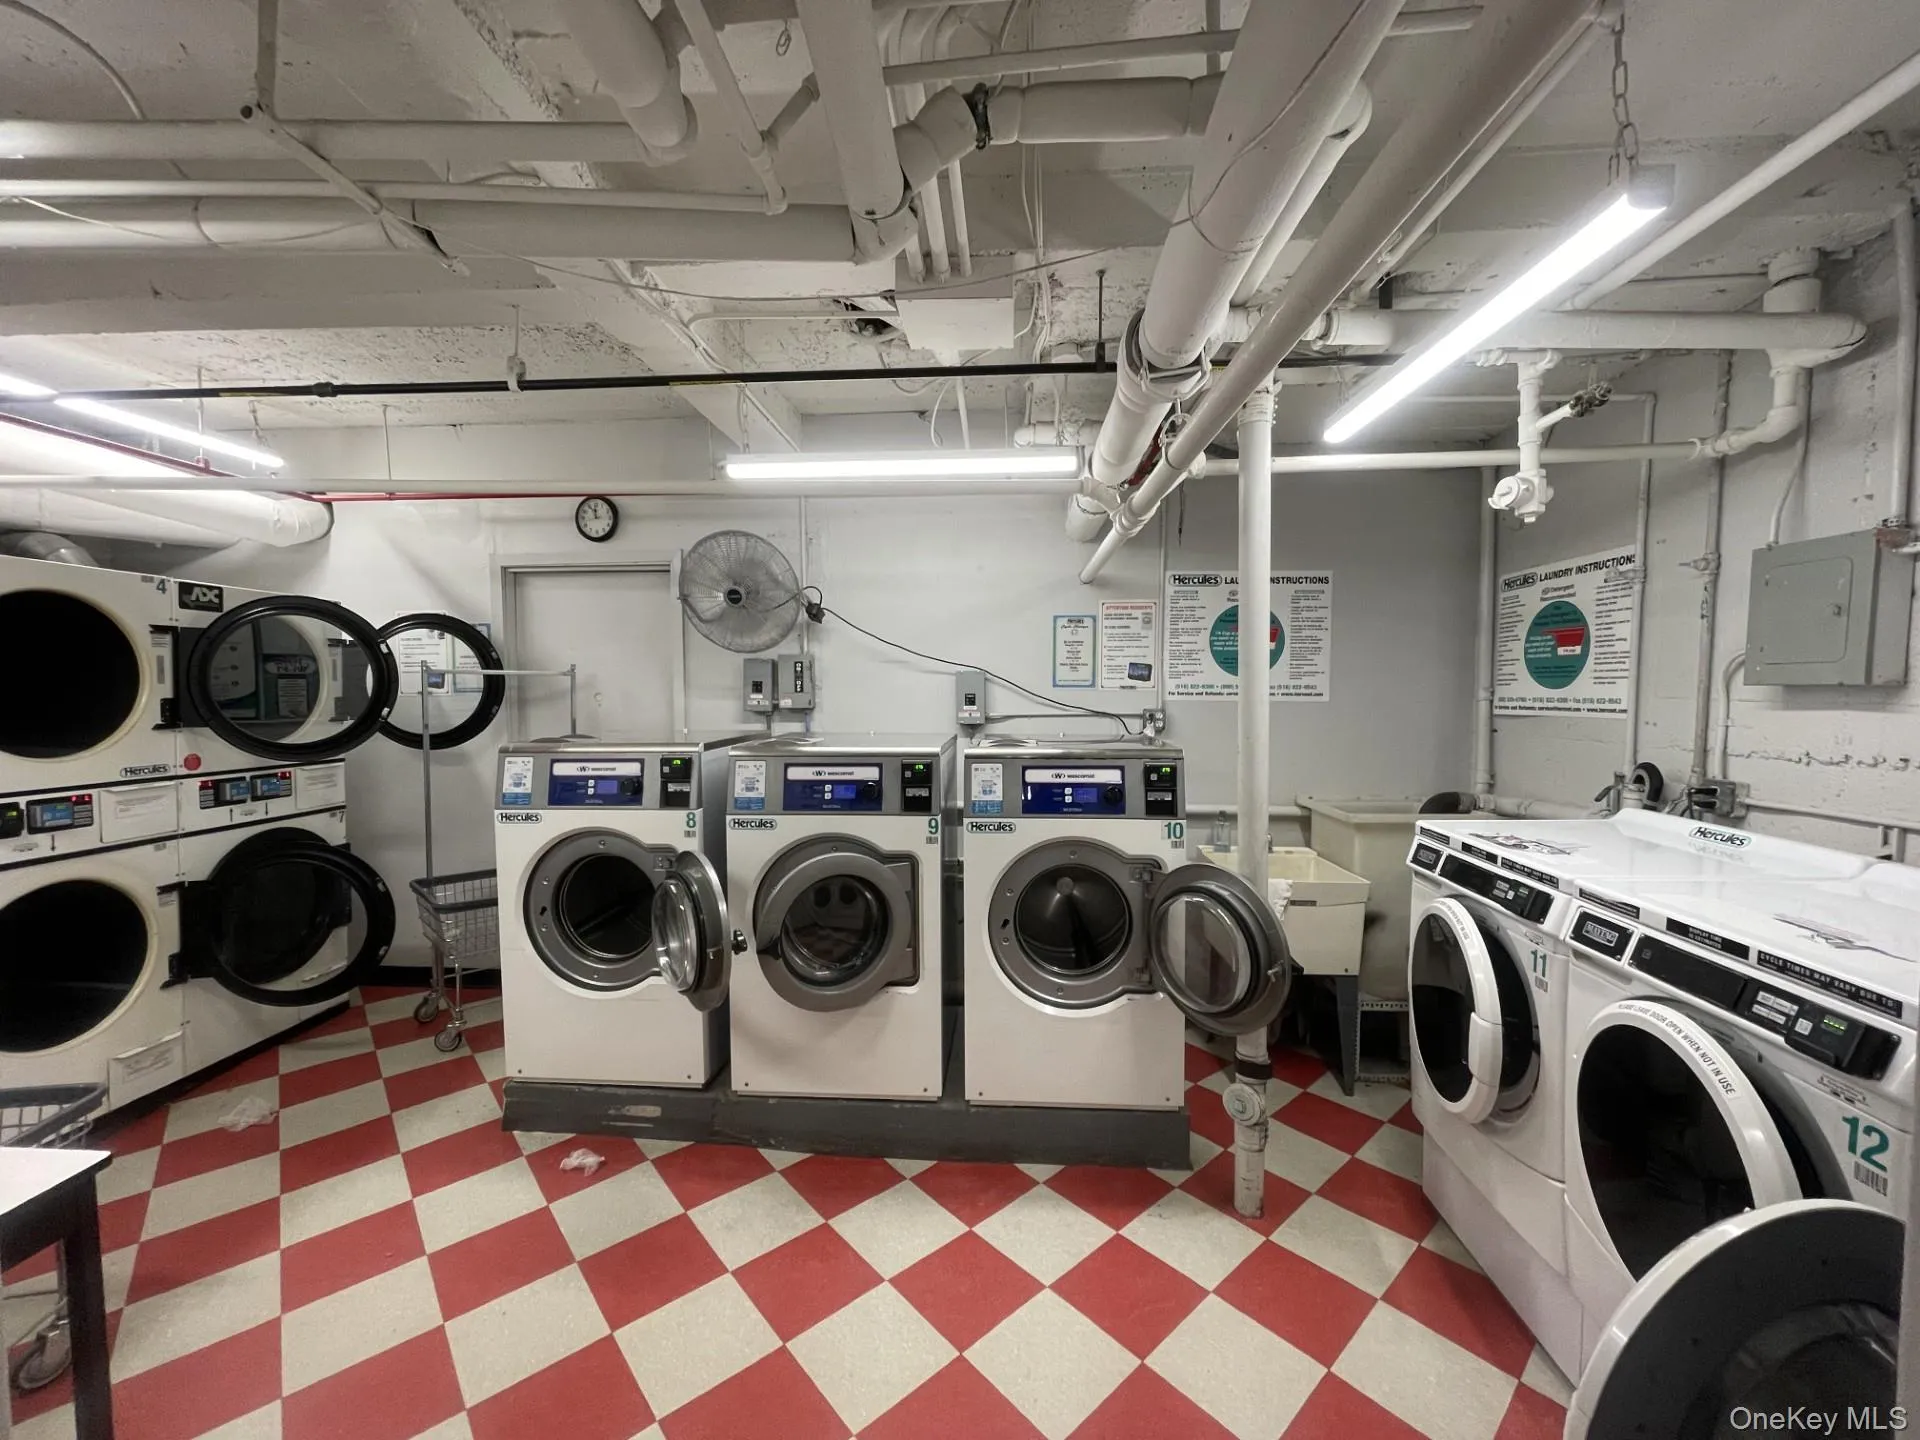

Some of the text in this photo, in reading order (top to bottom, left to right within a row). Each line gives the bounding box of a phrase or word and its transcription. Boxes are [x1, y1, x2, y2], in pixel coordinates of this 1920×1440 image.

[156, 578, 167, 594] 4
[1173, 574, 1219, 585] Hercules
[1270, 576, 1330, 584] NSTRUCTIONS
[1503, 574, 1536, 588] Hercules
[1539, 568, 1574, 582] LAUNDRY
[124, 765, 168, 776] Hercules
[500, 812, 696, 828] Hercules 8
[733, 817, 939, 835] Hercules 9
[970, 822, 1184, 840] Hercules 10
[1694, 826, 1746, 846] Hercules
[1530, 950, 1547, 978] 11
[1760, 952, 1783, 966] CYCLE
[1786, 962, 1810, 976] TIMES
[1814, 971, 1830, 983] MAY
[1834, 980, 1857, 994] VARY
[1860, 988, 1877, 1001] DUE
[1665, 1020, 1686, 1036] OPEN
[1680, 1033, 1702, 1053] WHEN
[1699, 1050, 1716, 1067] NOT
[1711, 1067, 1722, 1078] IN
[1718, 1077, 1736, 1096] USE
[1842, 1116, 1890, 1172] 12
